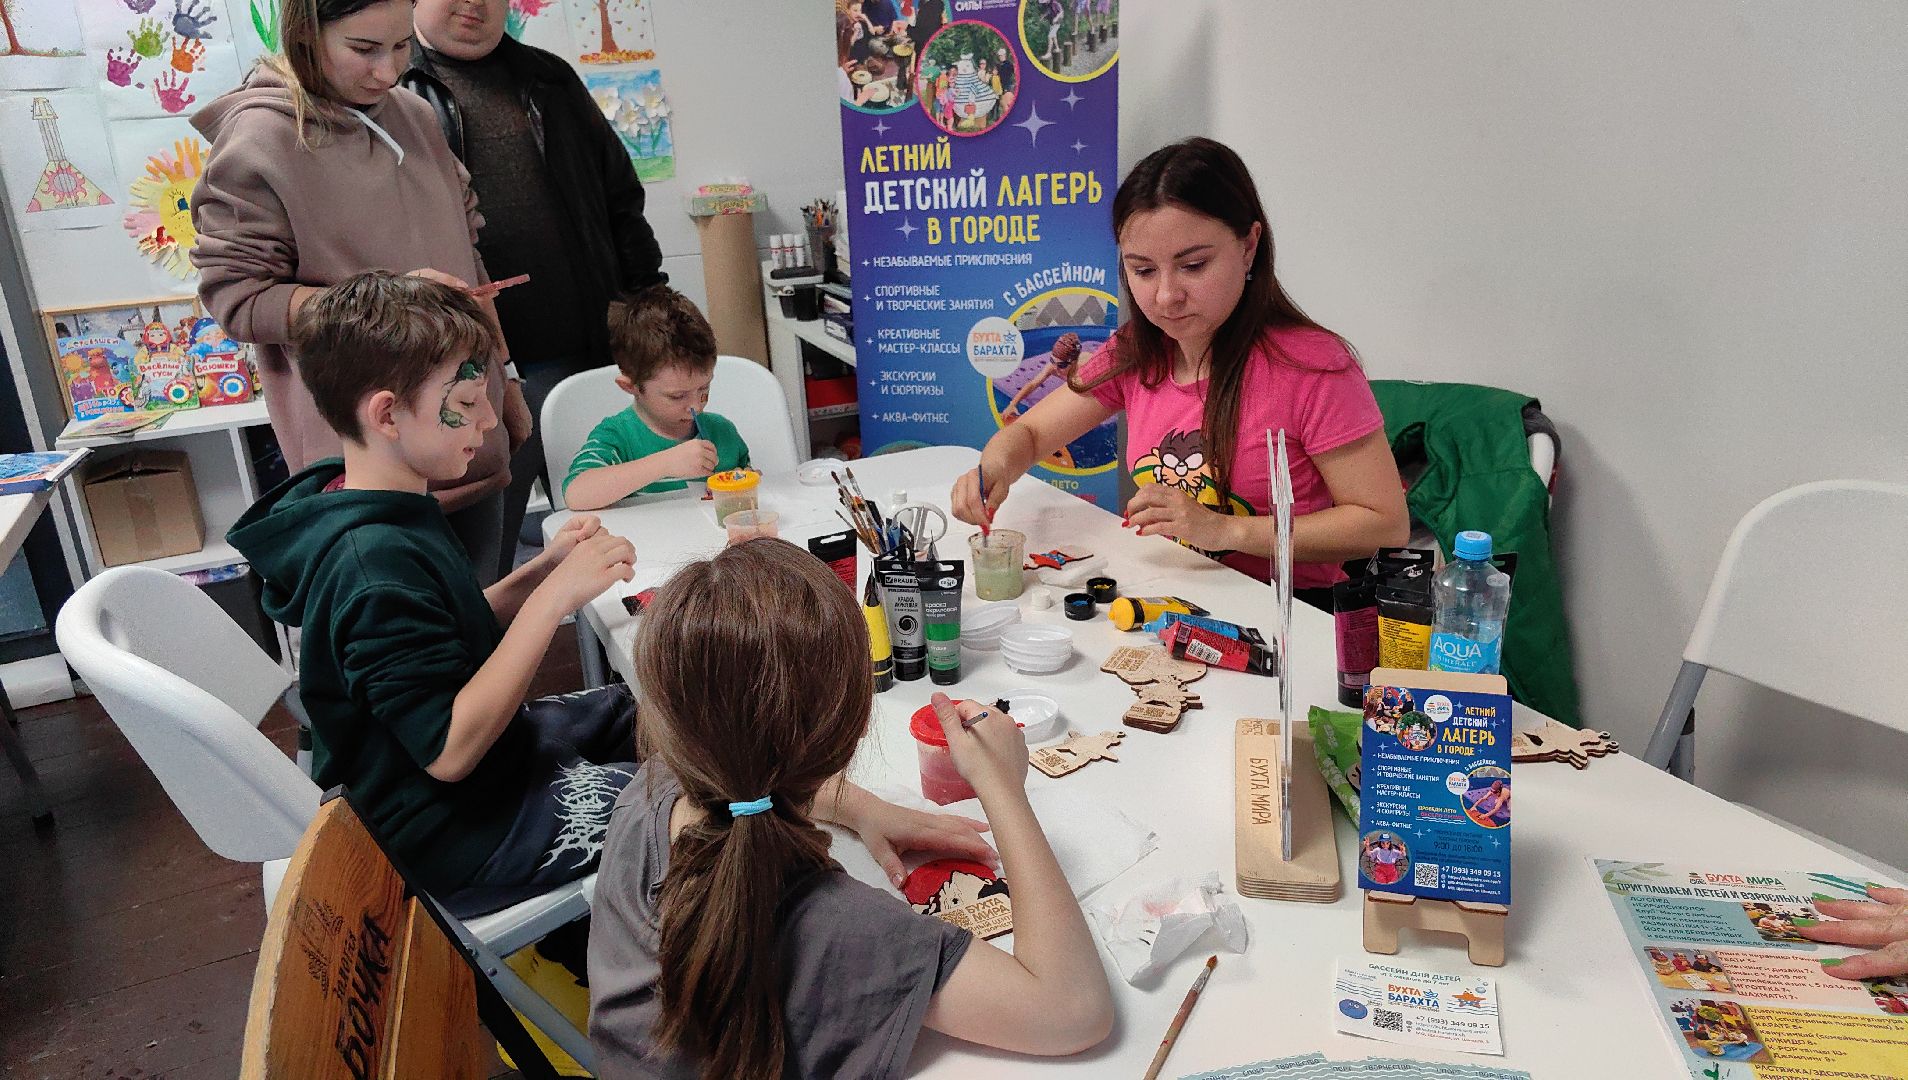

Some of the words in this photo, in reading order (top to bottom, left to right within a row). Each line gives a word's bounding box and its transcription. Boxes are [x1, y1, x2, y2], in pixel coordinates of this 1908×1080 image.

[860, 136, 951, 173] ЛЕТНИЙ
[864, 168, 987, 215] ДЕТСКИЙ
[997, 170, 1102, 207] ЛАГЕРЬ
[927, 217, 942, 245] В
[951, 214, 1041, 245] ГОРОДЕ
[874, 255, 952, 267] НЕЗАБЫВАЕМЫЕ
[955, 253, 1032, 266] ПРИКЛЮЧЕНИЯ
[875, 285, 940, 297] СПОРТИВНЫЕ
[1003, 292, 1016, 307] С
[1015, 262, 1105, 299] БАССЕЙНОМ
[876, 300, 884, 311] И
[886, 300, 946, 311] ТВОРЧЕСКИЕ
[949, 299, 994, 311] ЗАНЯТИЯ
[878, 329, 940, 340] КРЕАТИВНЫЕ
[878, 343, 961, 354] МАСТЕР-КЛАССЫ
[973, 345, 1017, 355] БАРАХТА
[880, 371, 936, 382] ЭКСКУРСИИ
[881, 385, 889, 395] И
[891, 384, 944, 396] СЮРПРИЗЫ
[882, 412, 950, 423] АКВА-ФИТНЕС
[1434, 636, 1481, 660] AQUA
[1465, 707, 1496, 717] ЛЕТНИЙ
[1453, 716, 1488, 727] ДЕТСКИЙ
[1442, 727, 1495, 746] ЛАГЕРЬ
[1437, 745, 1442, 753] В
[1445, 745, 1475, 756] ГОРОДЕ
[1250, 758, 1269, 791] БУХТА
[1252, 794, 1272, 825] МИРА
[1705, 873, 1744, 884] БУХТА
[1745, 876, 1784, 886] МИРА
[1616, 882, 1692, 896] ПРИГЛАШАЕМ
[1694, 887, 1730, 899] ДЕТЕЙ
[1730, 890, 1740, 899] И
[1740, 891, 1802, 904] ВЗРОСЛЫХ
[965, 897, 1003, 914] БУХТА
[971, 904, 1010, 922] МИРА
[1368, 963, 1409, 975] БАССЕЙН
[1410, 969, 1430, 979] ДЛЯ
[1431, 971, 1461, 982] ДЕТЕЙ
[335, 909, 392, 1080] БОЧКА
[1388, 983, 1421, 996] БУХТА
[1388, 993, 1440, 1008] БАРАХТА
